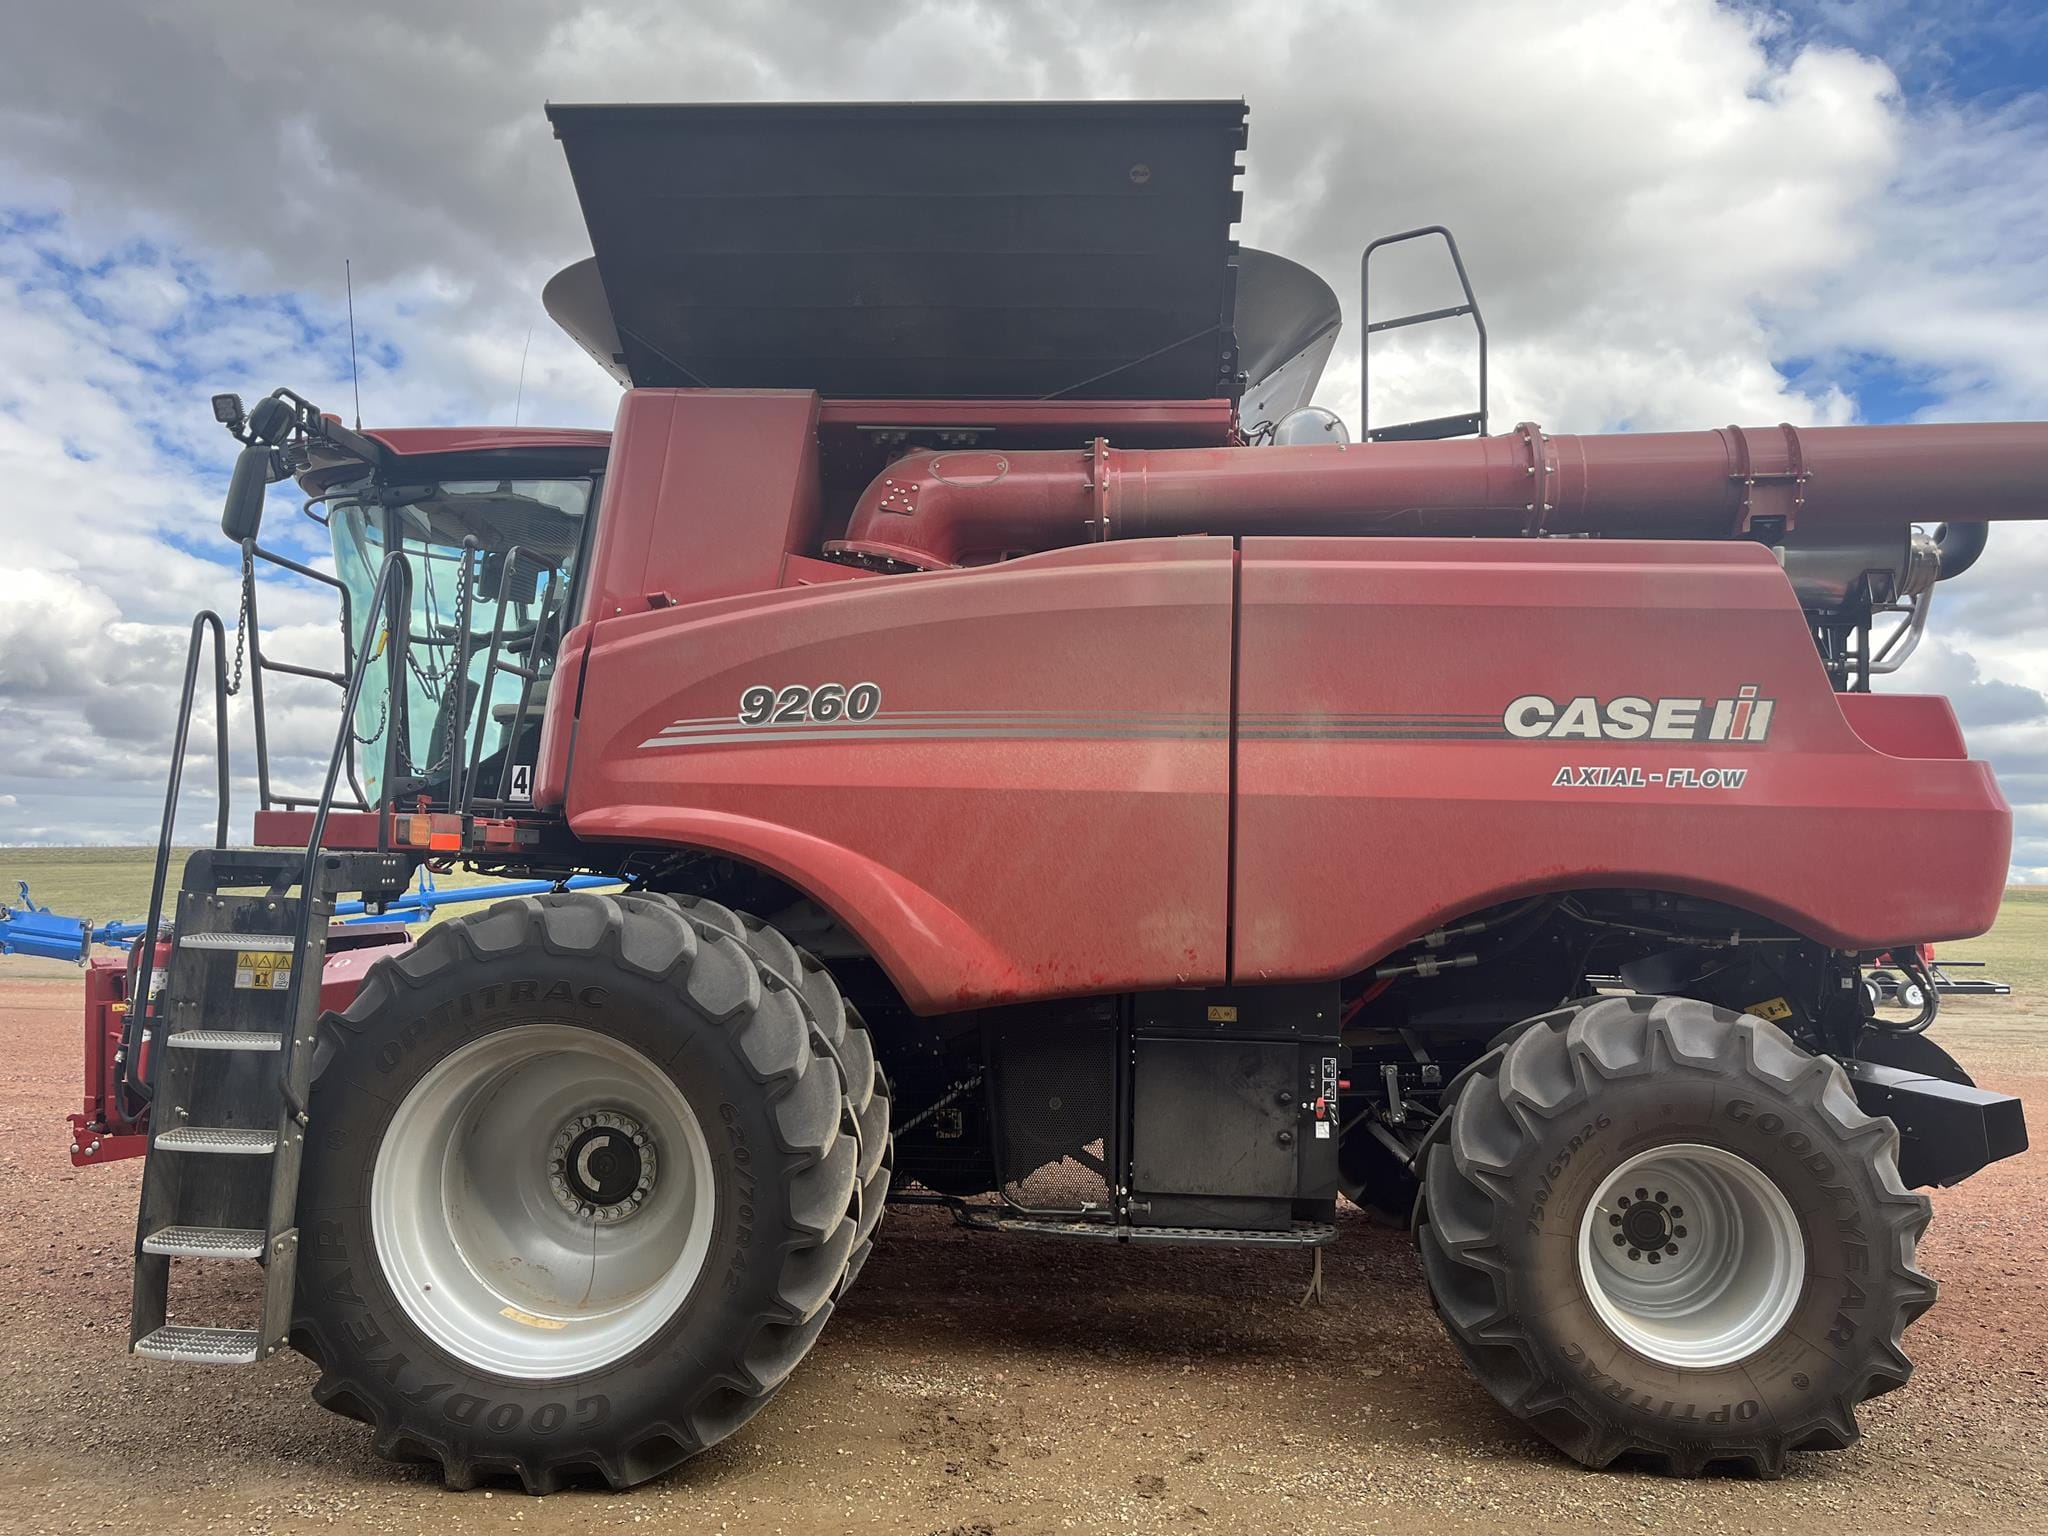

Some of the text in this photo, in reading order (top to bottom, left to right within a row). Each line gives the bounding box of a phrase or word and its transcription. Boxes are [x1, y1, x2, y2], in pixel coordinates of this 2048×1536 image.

[739, 682, 881, 725] 9260
[1503, 695, 1701, 739] CASE
[513, 766, 528, 794] 4
[376, 979, 610, 1074] OPTITRAC
[1527, 1112, 1611, 1236] 750/65R26
[1725, 1099, 1870, 1350] GOODYEAR
[310, 1218, 611, 1435] GOODYEAR
[1559, 1341, 1760, 1425] OPTITRAC
